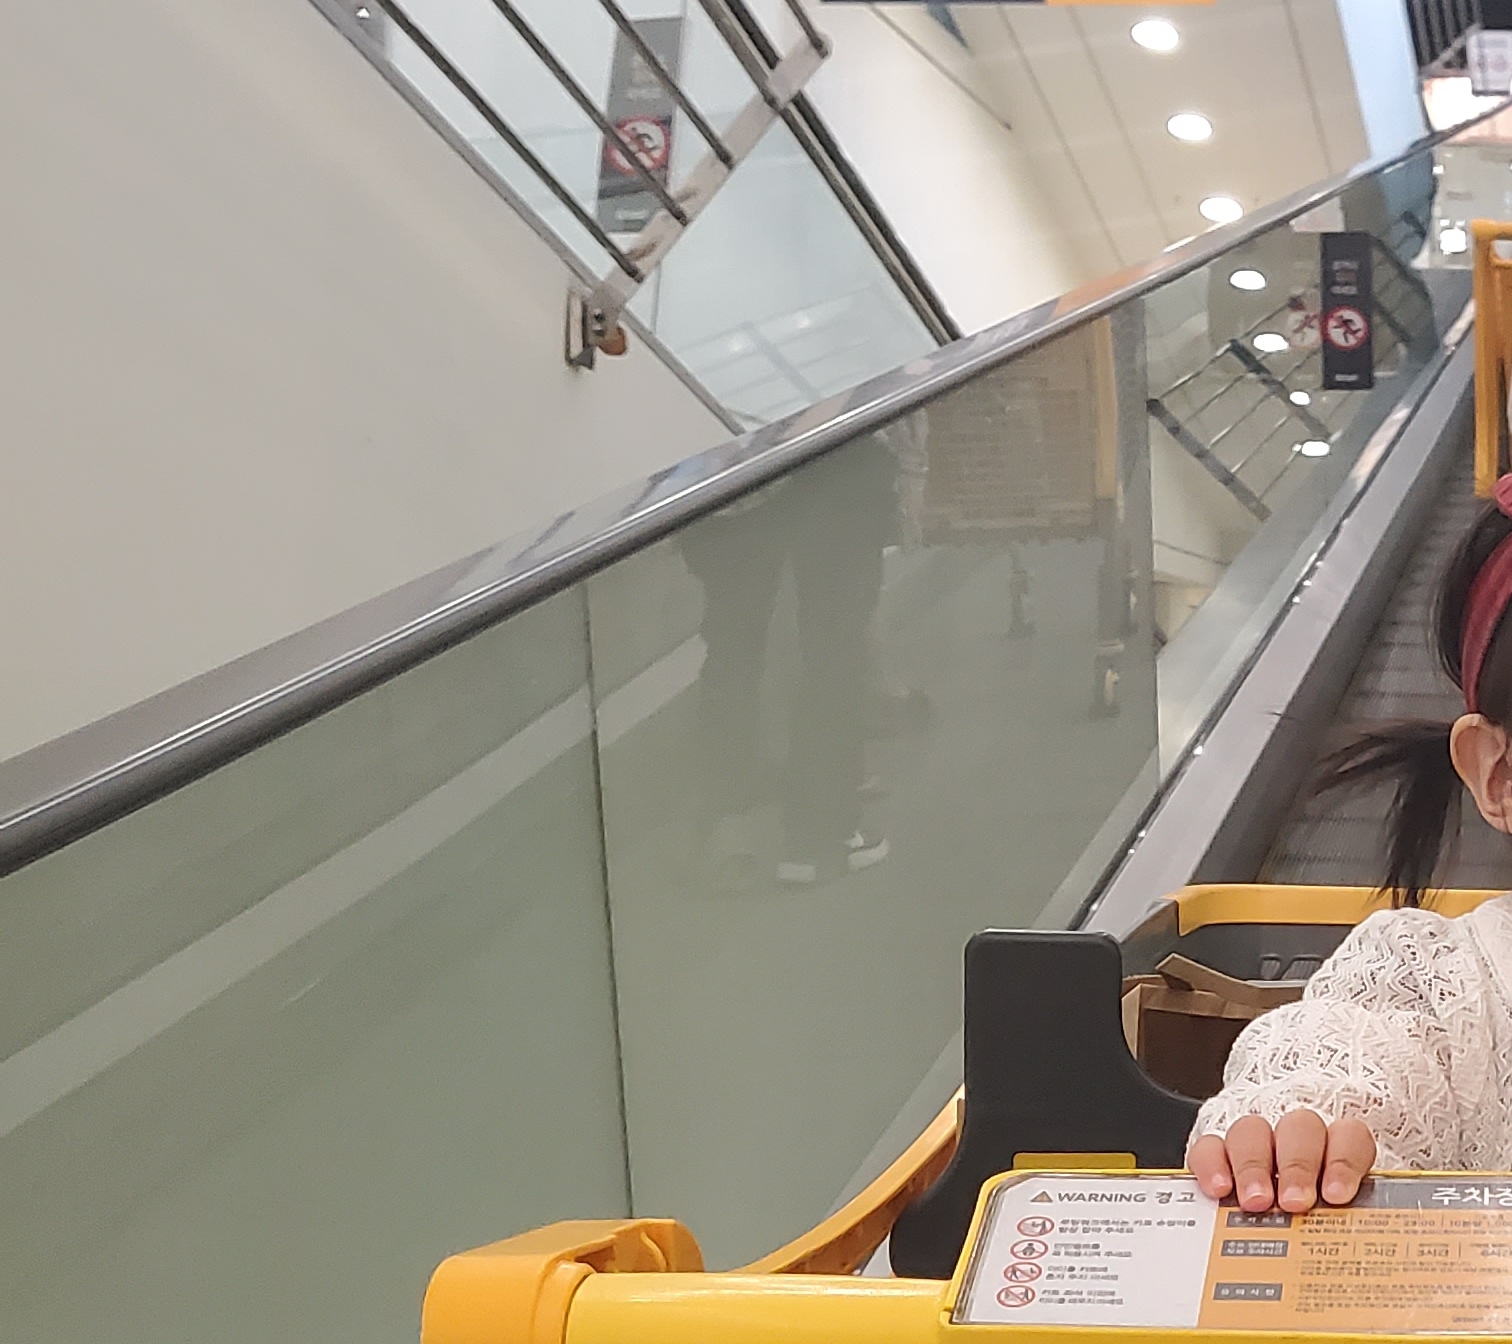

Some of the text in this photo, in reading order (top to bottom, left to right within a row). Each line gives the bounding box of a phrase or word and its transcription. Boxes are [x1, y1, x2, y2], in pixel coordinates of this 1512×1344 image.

[1058, 1191, 1196, 1204] WARNING 경고
[1308, 1247, 1340, 1256] 1시간
[1364, 1248, 1397, 1257] 2시간
[1417, 1248, 1449, 1257] 3시간
